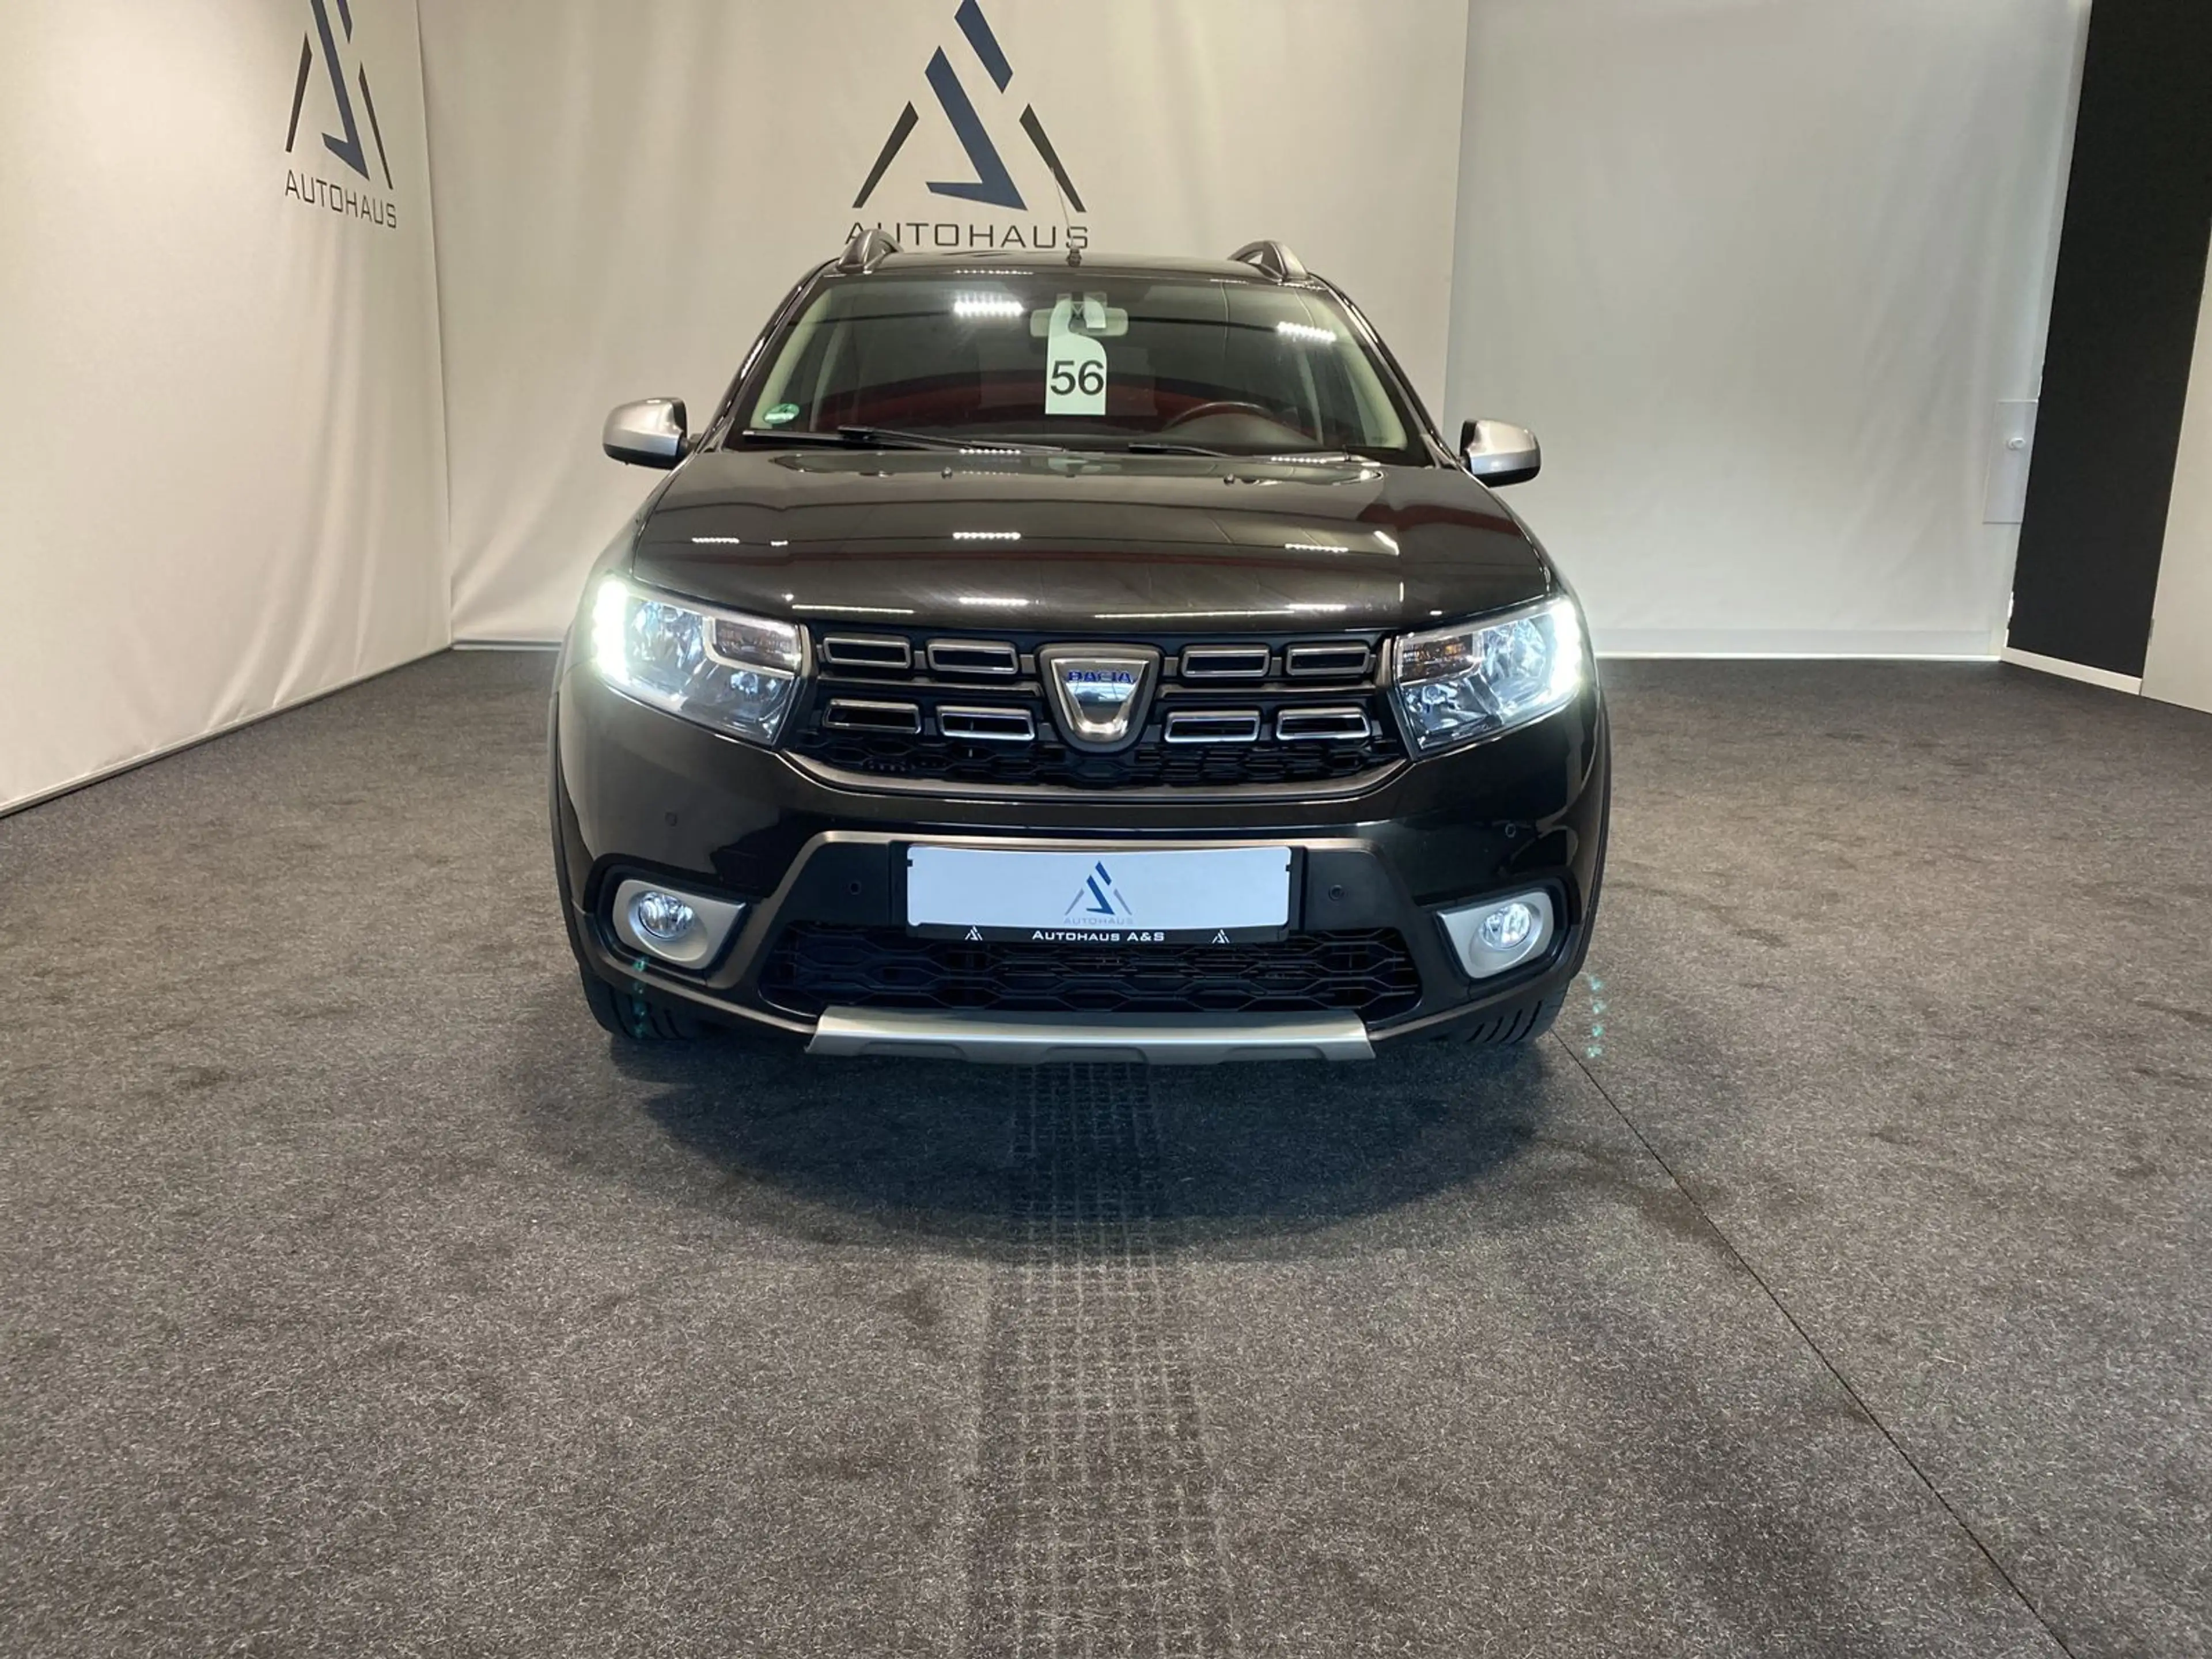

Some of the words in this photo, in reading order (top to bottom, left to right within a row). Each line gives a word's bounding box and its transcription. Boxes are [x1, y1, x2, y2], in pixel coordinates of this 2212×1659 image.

[285, 169, 397, 229] AUTOHAUS
[1050, 360, 1104, 396] 56
[1063, 917, 1134, 926] AUTOHAUS
[1032, 930, 1120, 942] AUTOHAUS
[1126, 931, 1165, 942] A&S
